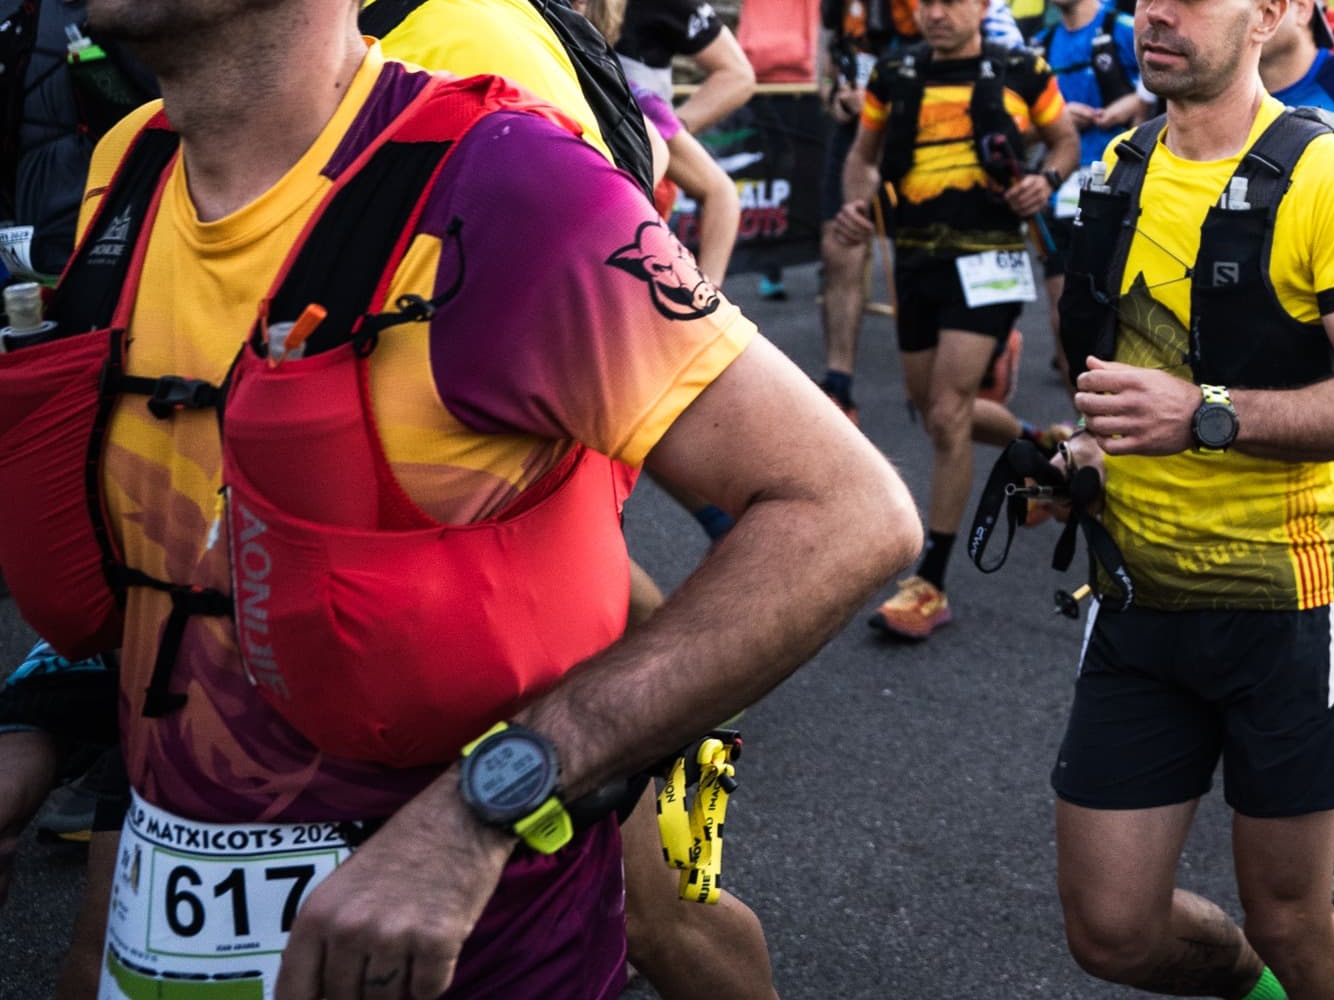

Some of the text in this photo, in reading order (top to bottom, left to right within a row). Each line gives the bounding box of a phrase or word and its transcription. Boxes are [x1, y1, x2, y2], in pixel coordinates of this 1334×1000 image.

[239, 503, 291, 701] AONIJIE
[146, 817, 284, 850] MATXICOTS
[292, 822, 340, 845] 202
[165, 864, 315, 937] 617
